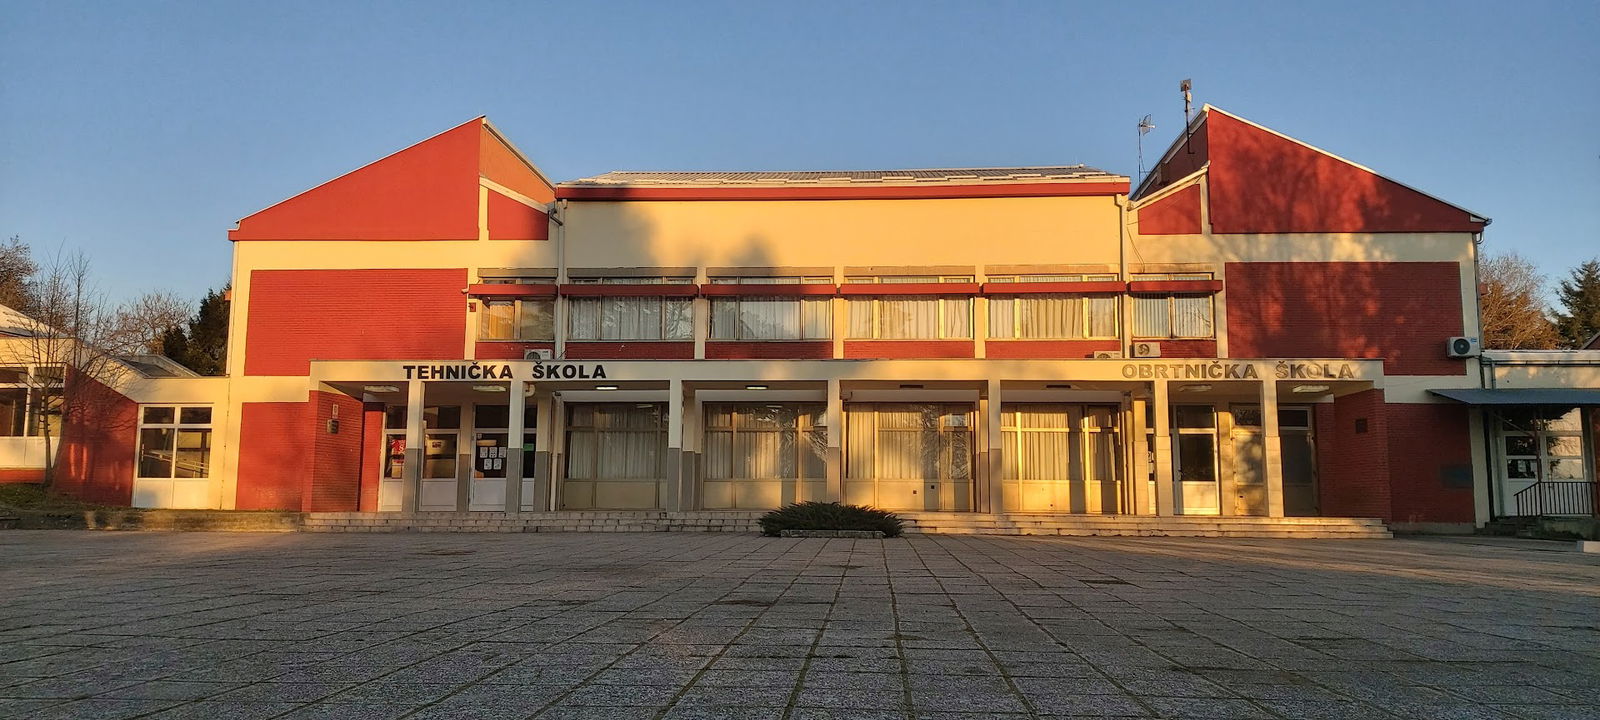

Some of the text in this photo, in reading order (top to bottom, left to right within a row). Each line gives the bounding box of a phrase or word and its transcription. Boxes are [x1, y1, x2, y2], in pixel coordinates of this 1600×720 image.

[403, 362, 607, 379] TEHNIČKA ŠKOLA
[1121, 361, 1354, 379] OBRTNIČKA ŠKOLA
